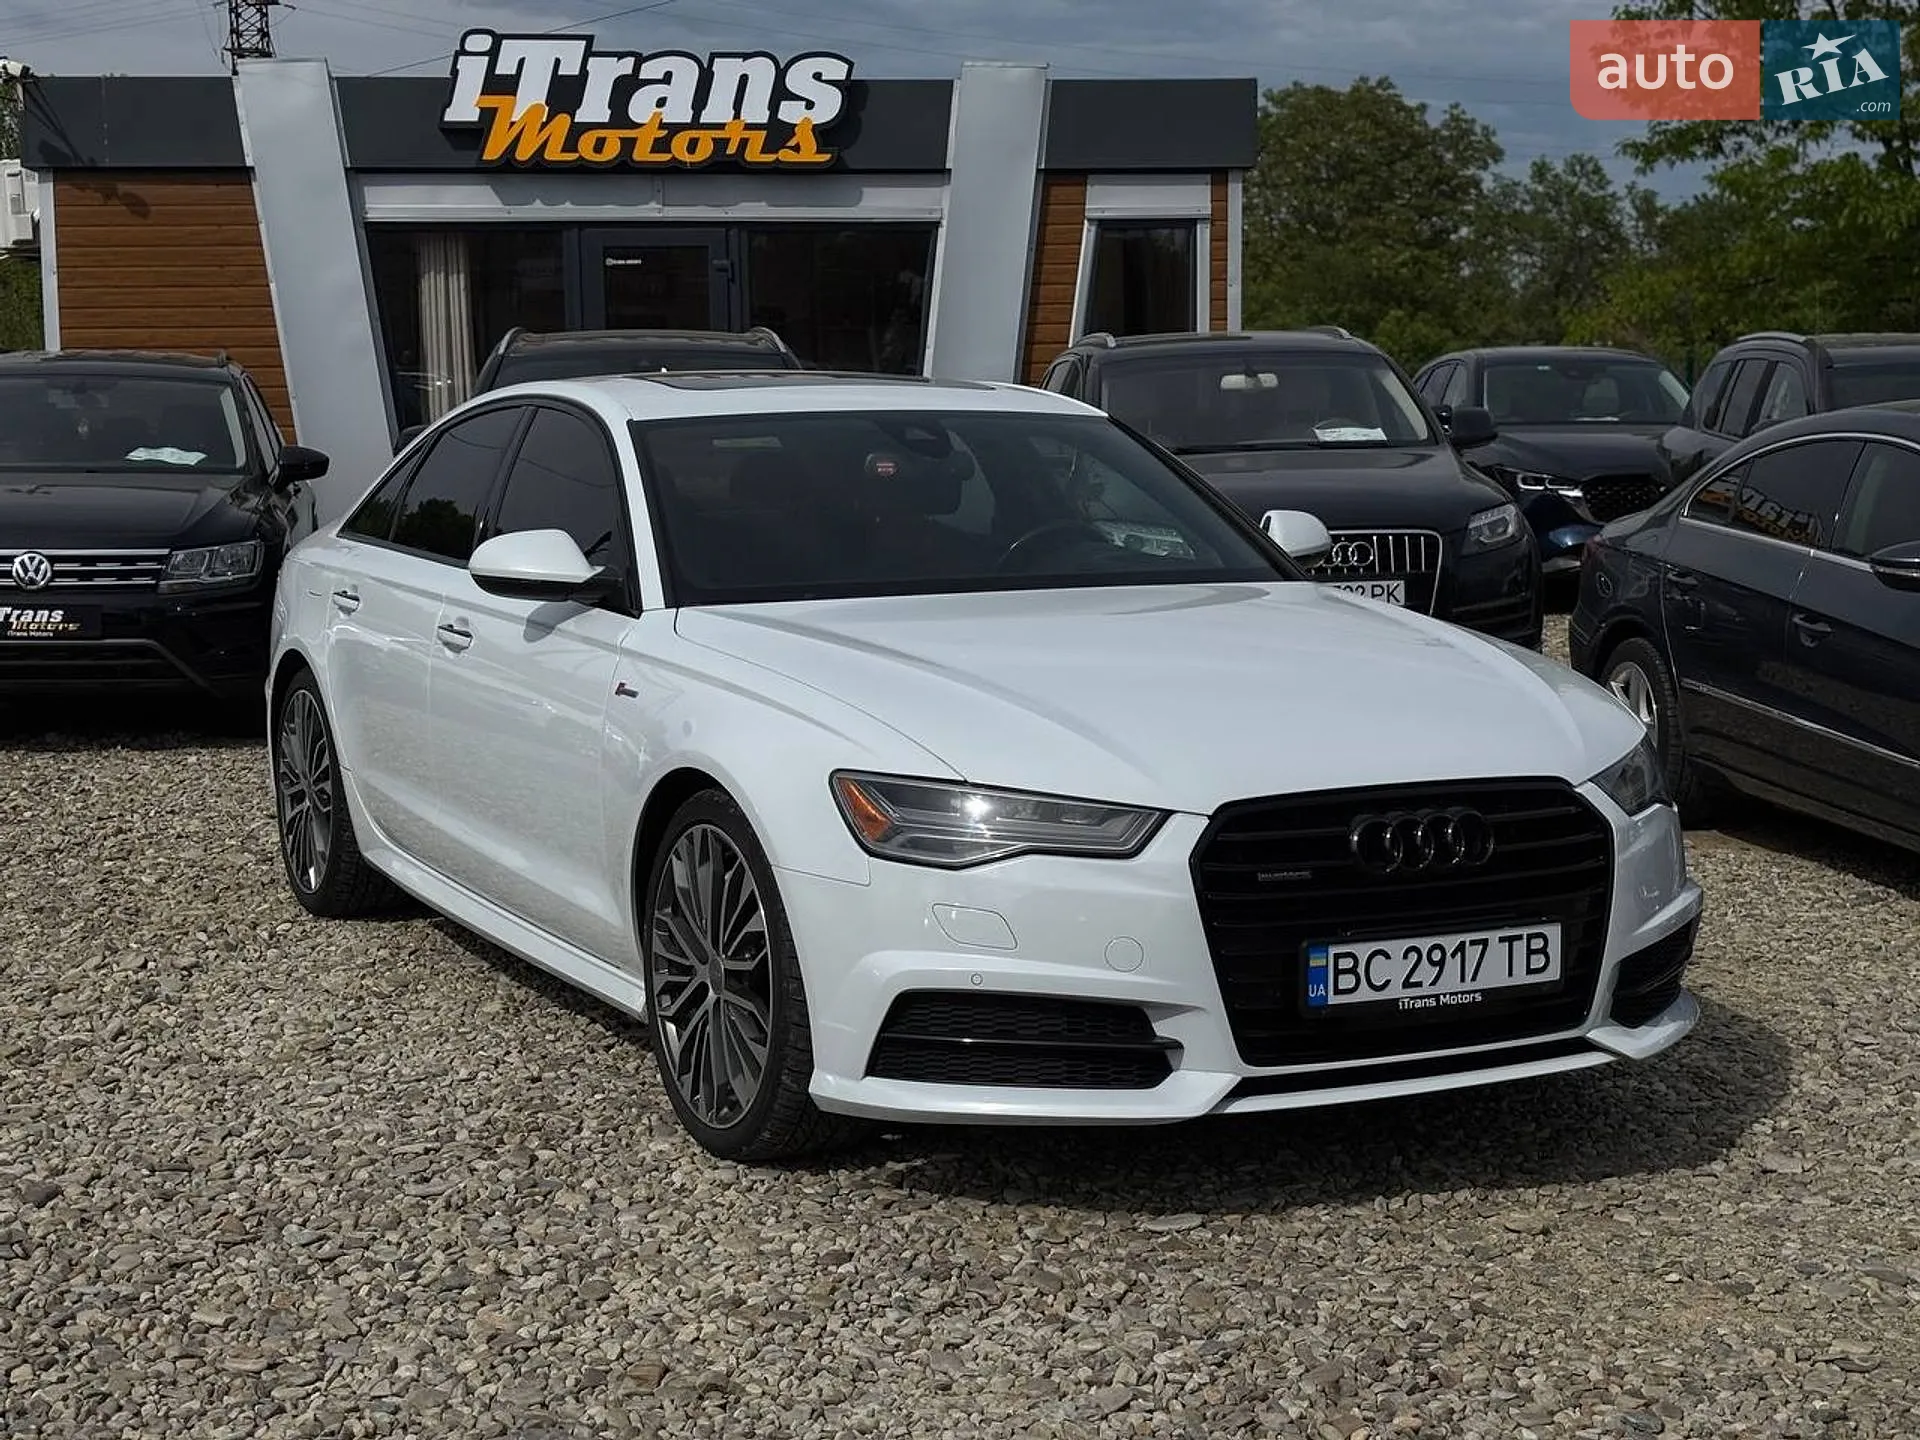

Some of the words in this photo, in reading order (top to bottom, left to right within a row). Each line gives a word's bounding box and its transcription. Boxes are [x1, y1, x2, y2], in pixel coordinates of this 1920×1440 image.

[443, 33, 849, 125] iTrans
[473, 94, 832, 163] Motors
[1308, 983, 1326, 998] UA
[1332, 948, 1392, 996] BC
[1401, 937, 1490, 989] 2917
[1498, 931, 1551, 978] TB
[1440, 992, 1482, 1006] Motors
